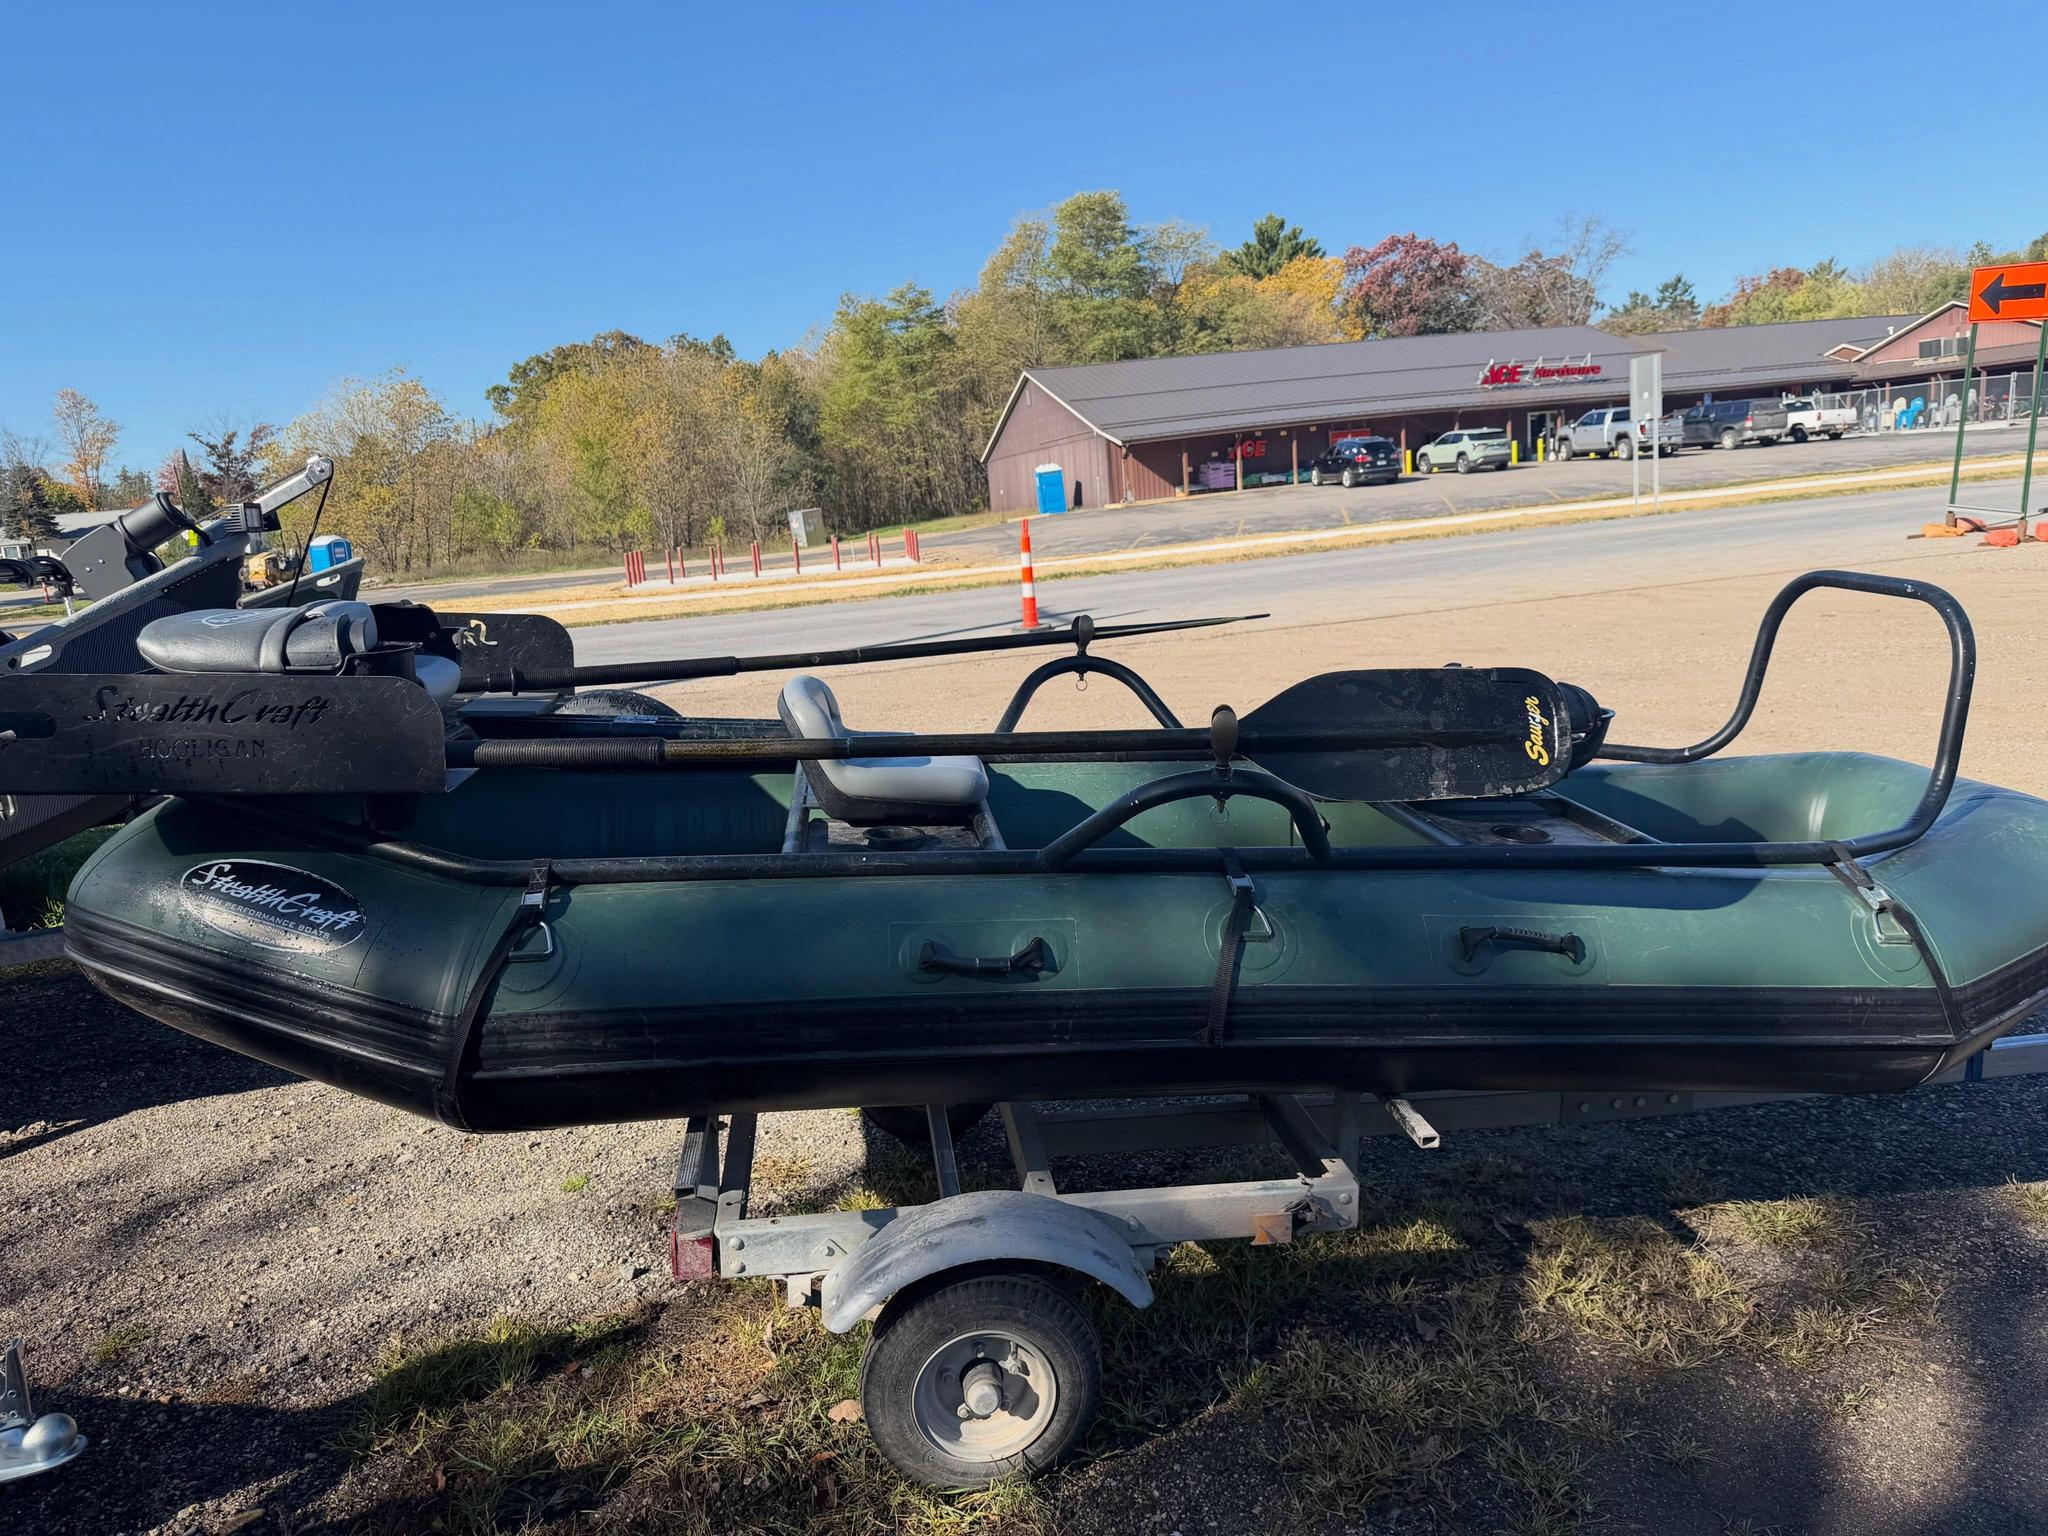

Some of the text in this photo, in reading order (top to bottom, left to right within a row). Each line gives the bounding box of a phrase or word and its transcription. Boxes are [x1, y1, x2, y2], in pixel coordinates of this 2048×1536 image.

[1480, 363, 1602, 385] ACE Hardware
[1228, 440, 1267, 459] ACE
[84, 685, 331, 729] StealthCraft
[139, 738, 269, 759] HOOLIGAN
[1524, 695, 1550, 766] Sawyer
[192, 864, 361, 931] StealthCraft
[199, 893, 223, 906] HIGH
[225, 901, 296, 928] PERFORMANCE
[297, 924, 331, 940] BOATS
